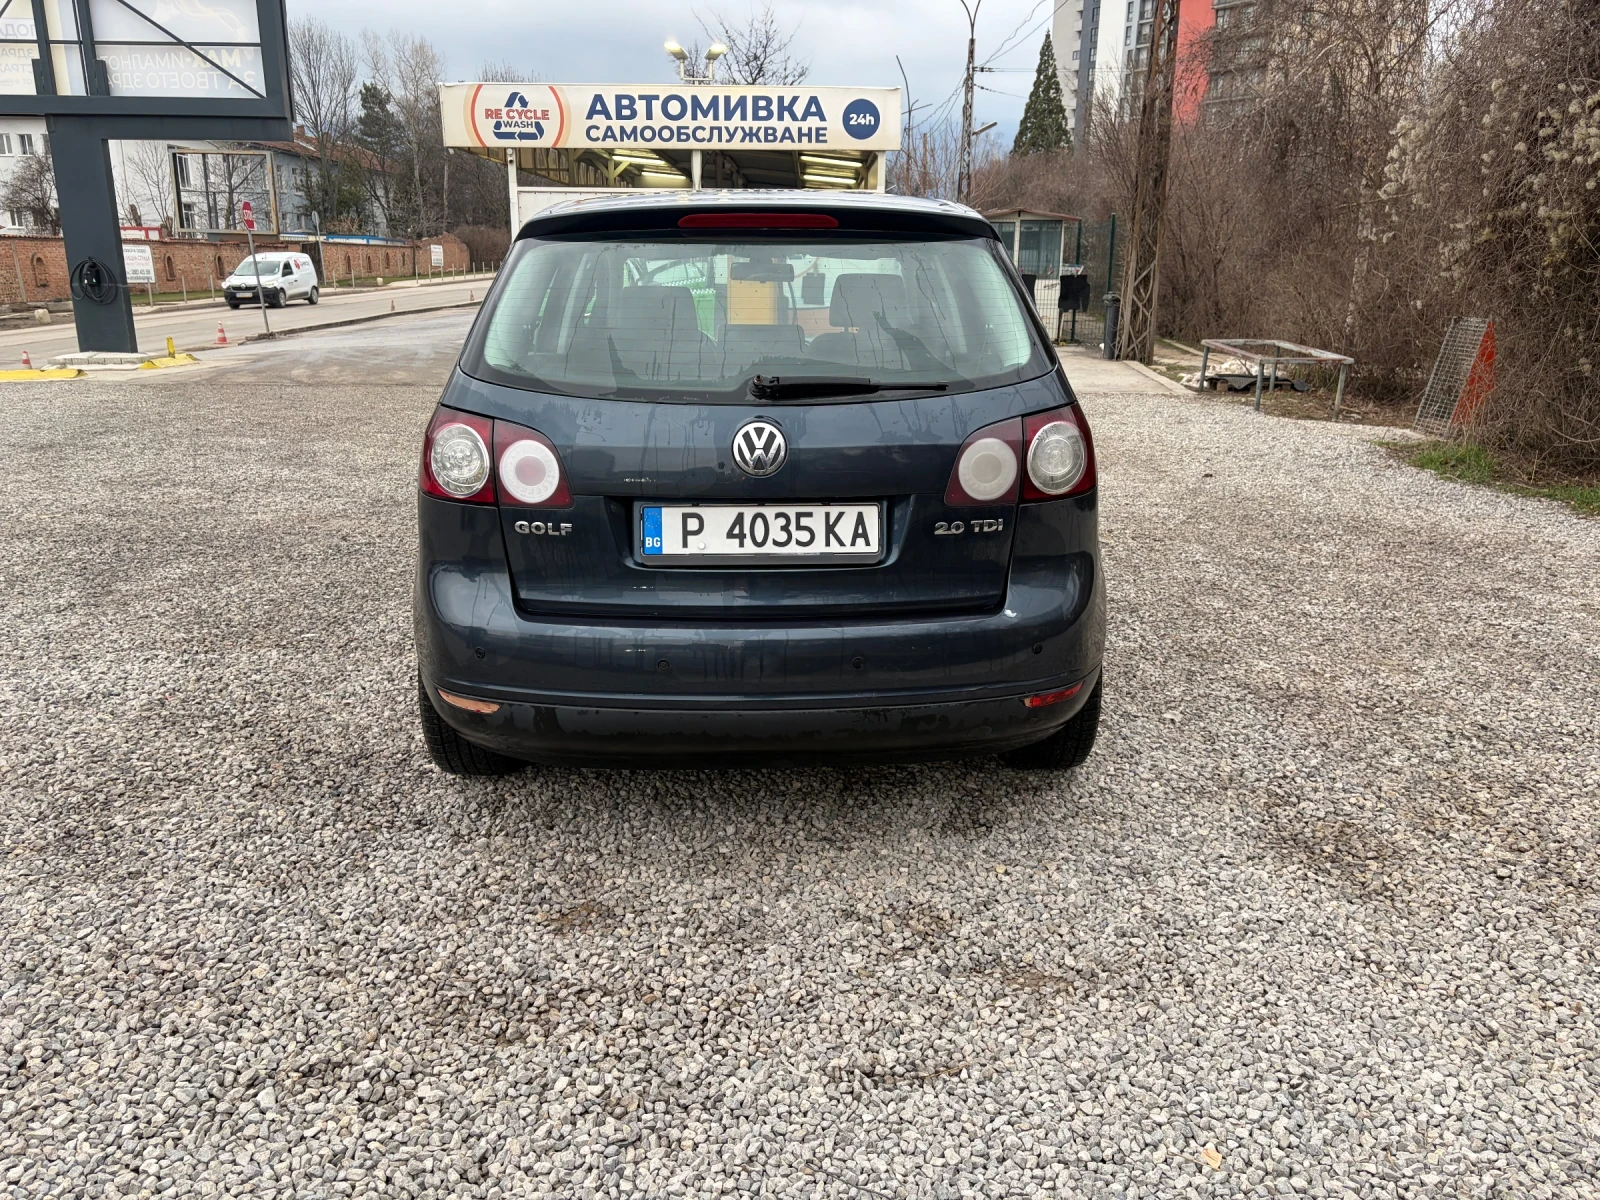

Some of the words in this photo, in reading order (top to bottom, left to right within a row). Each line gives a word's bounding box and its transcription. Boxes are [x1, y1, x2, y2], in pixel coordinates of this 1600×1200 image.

[484, 108, 503, 120] RE
[505, 108, 550, 121] CYCLE
[585, 93, 828, 122] АВТОМИВКА
[502, 120, 534, 129] WASH
[849, 113, 875, 126] 24h
[585, 124, 828, 144] САМООБСЛУЖВАНЕ
[514, 520, 573, 536] GOLF
[725, 511, 816, 549] 4035
[645, 536, 661, 548] BG
